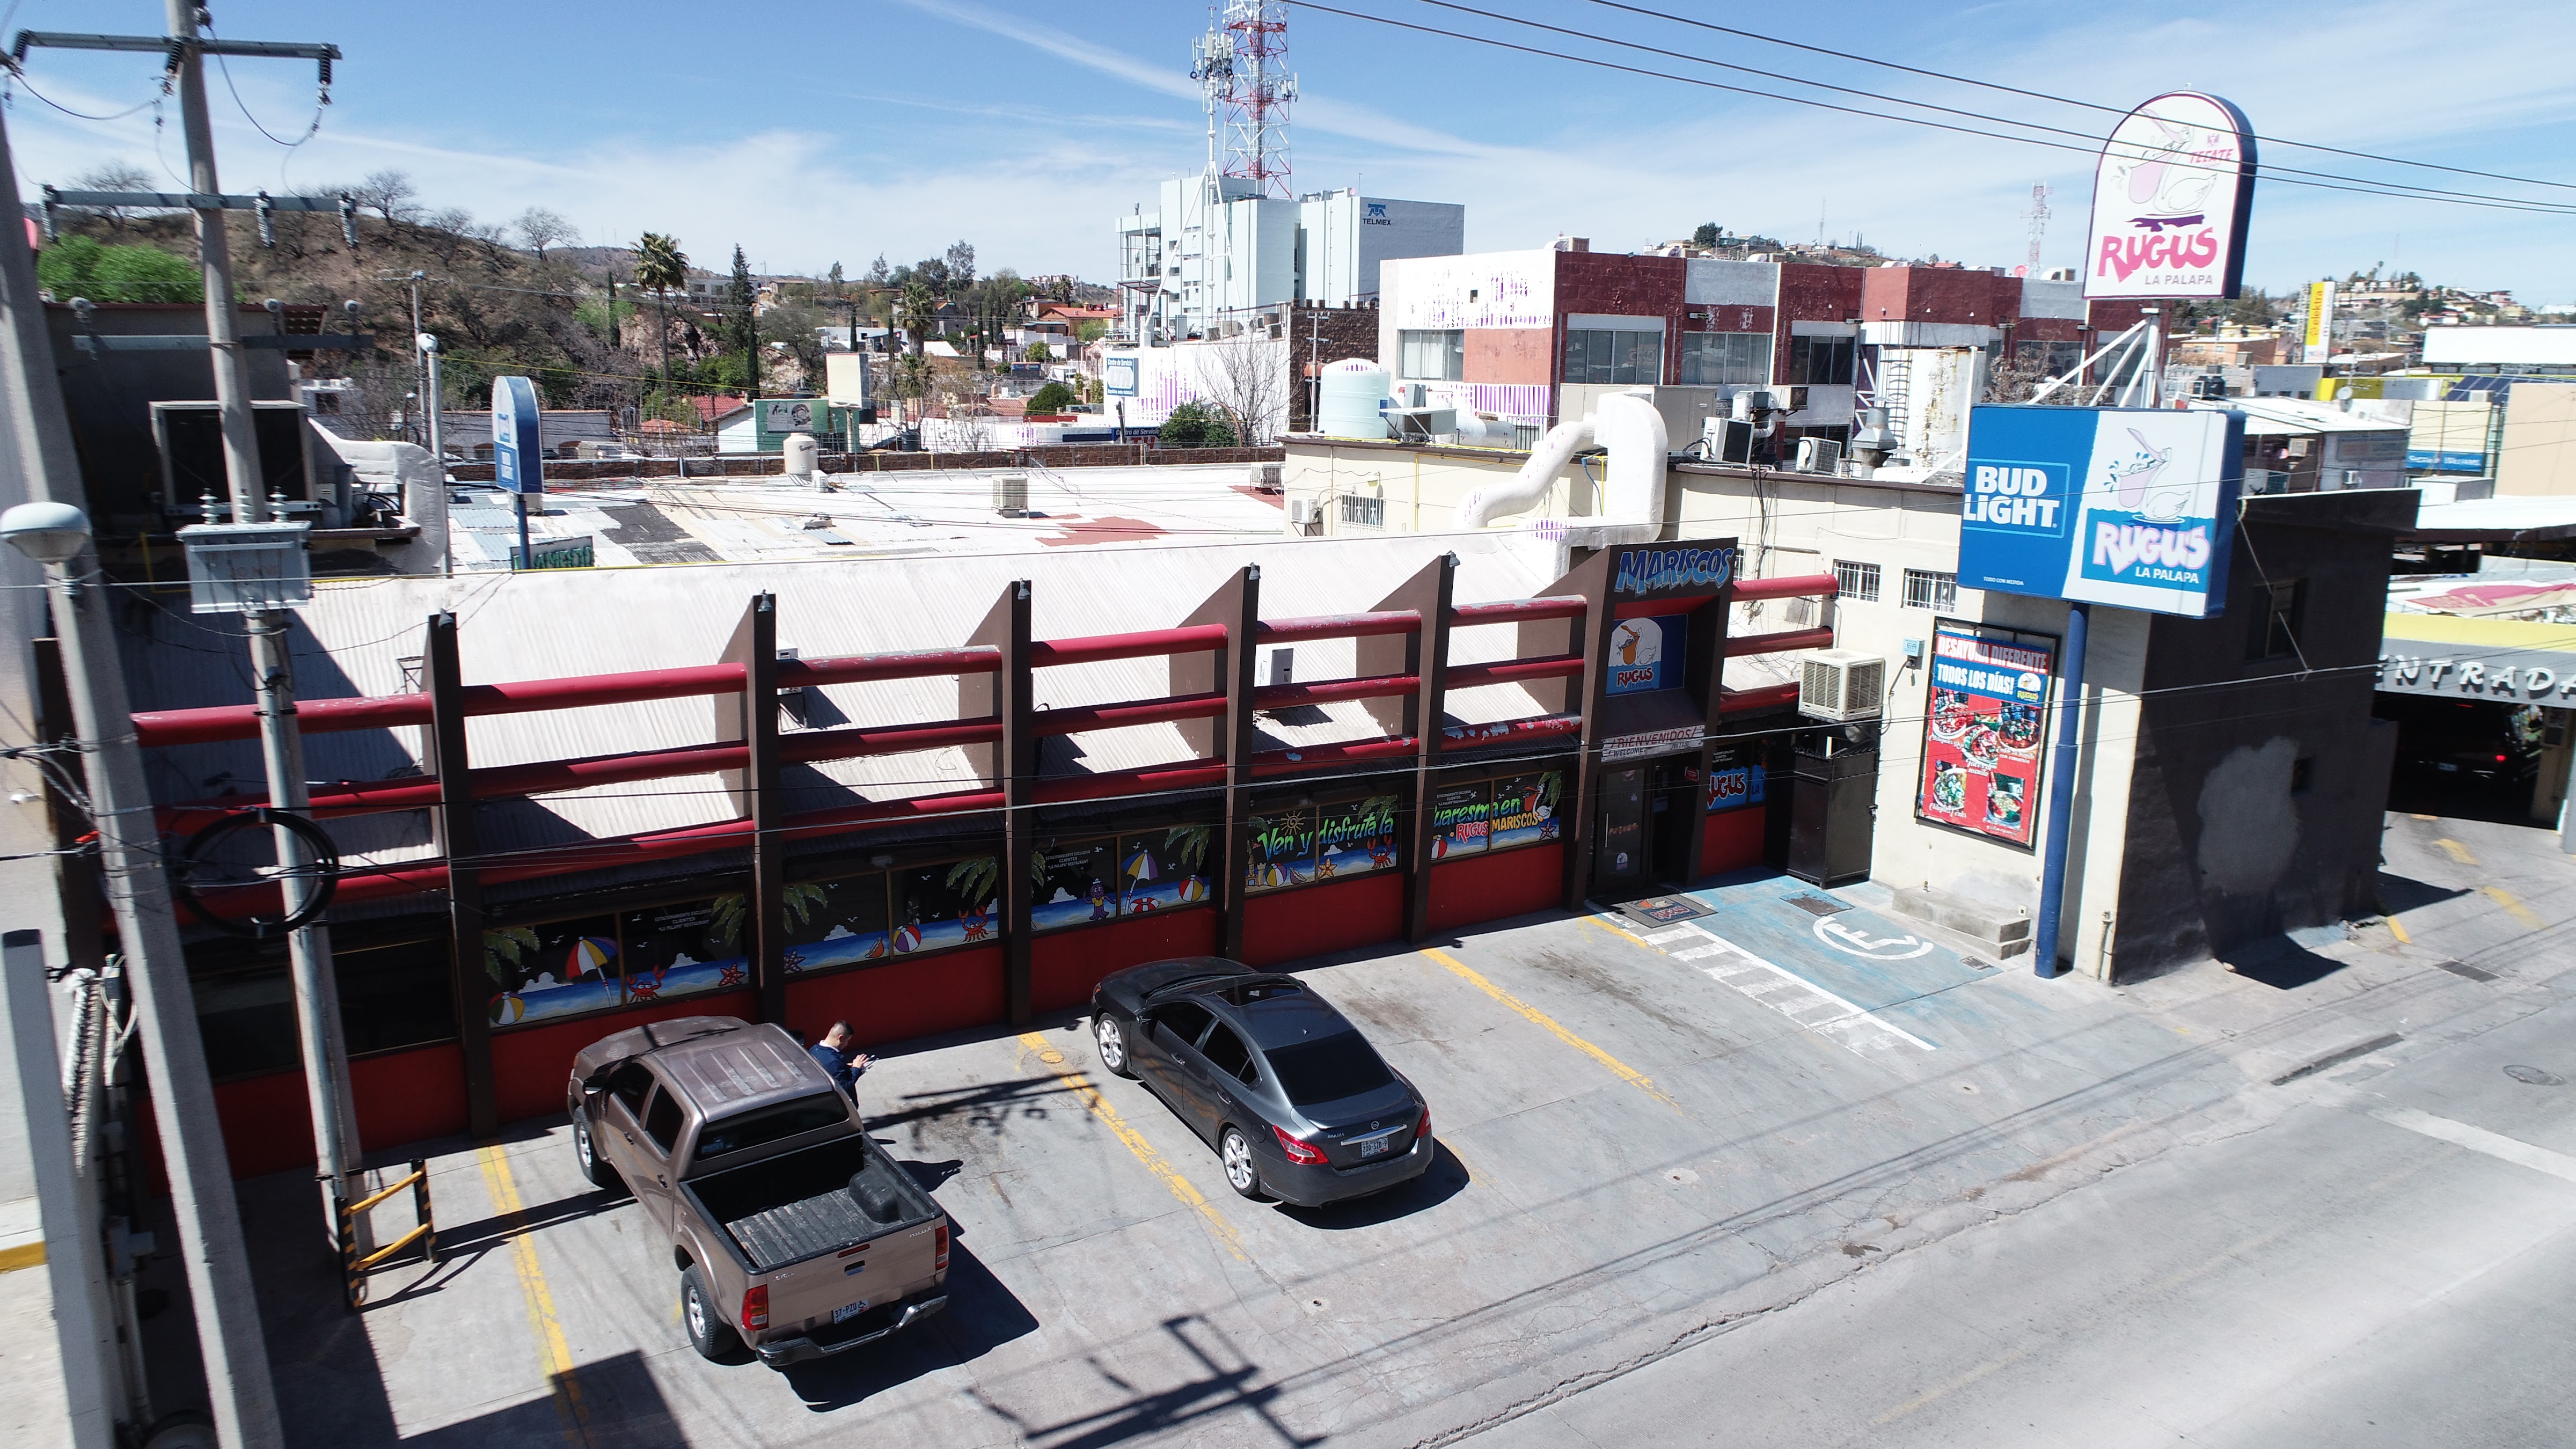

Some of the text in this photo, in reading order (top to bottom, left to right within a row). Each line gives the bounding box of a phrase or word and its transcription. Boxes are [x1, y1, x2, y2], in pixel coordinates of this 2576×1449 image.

[2190, 149, 2234, 164] TECATE
[2097, 226, 2218, 283] RUGUS
[2145, 275, 2213, 284] LA PALAPA
[2311, 291, 2323, 325] elektra
[1975, 465, 2047, 496] BUD
[1963, 492, 2060, 527] LIGHT
[2092, 522, 2210, 575] RUGUS
[1614, 547, 1735, 597] MARISCOS
[2135, 566, 2199, 584] LA PALAPA
[1937, 635, 2047, 674] DESAYUNA DIFERENTE
[1616, 667, 1653, 688] RUGUS
[1937, 663, 2015, 695] TODOS LOS DÍAS!
[2017, 690, 2039, 700] RUGUS
[1707, 773, 1747, 809] UGUS
[1752, 784, 1760, 795] LA
[1433, 797, 1520, 828] uaresma en
[1257, 808, 1394, 861] Ven y disfruta la
[1456, 811, 1539, 844] RUGUS MARISCOS
[1045, 852, 1073, 860] ESTACIONAMIENTO
[655, 912, 691, 921] ESTACIONAMIENTO
[684, 919, 709, 927] RESTAURANT
[1650, 904, 1690, 919] RUGUS
[1363, 1140, 1387, 1153] 200-SZD-9
[835, 1302, 857, 1318] 37-PZU
